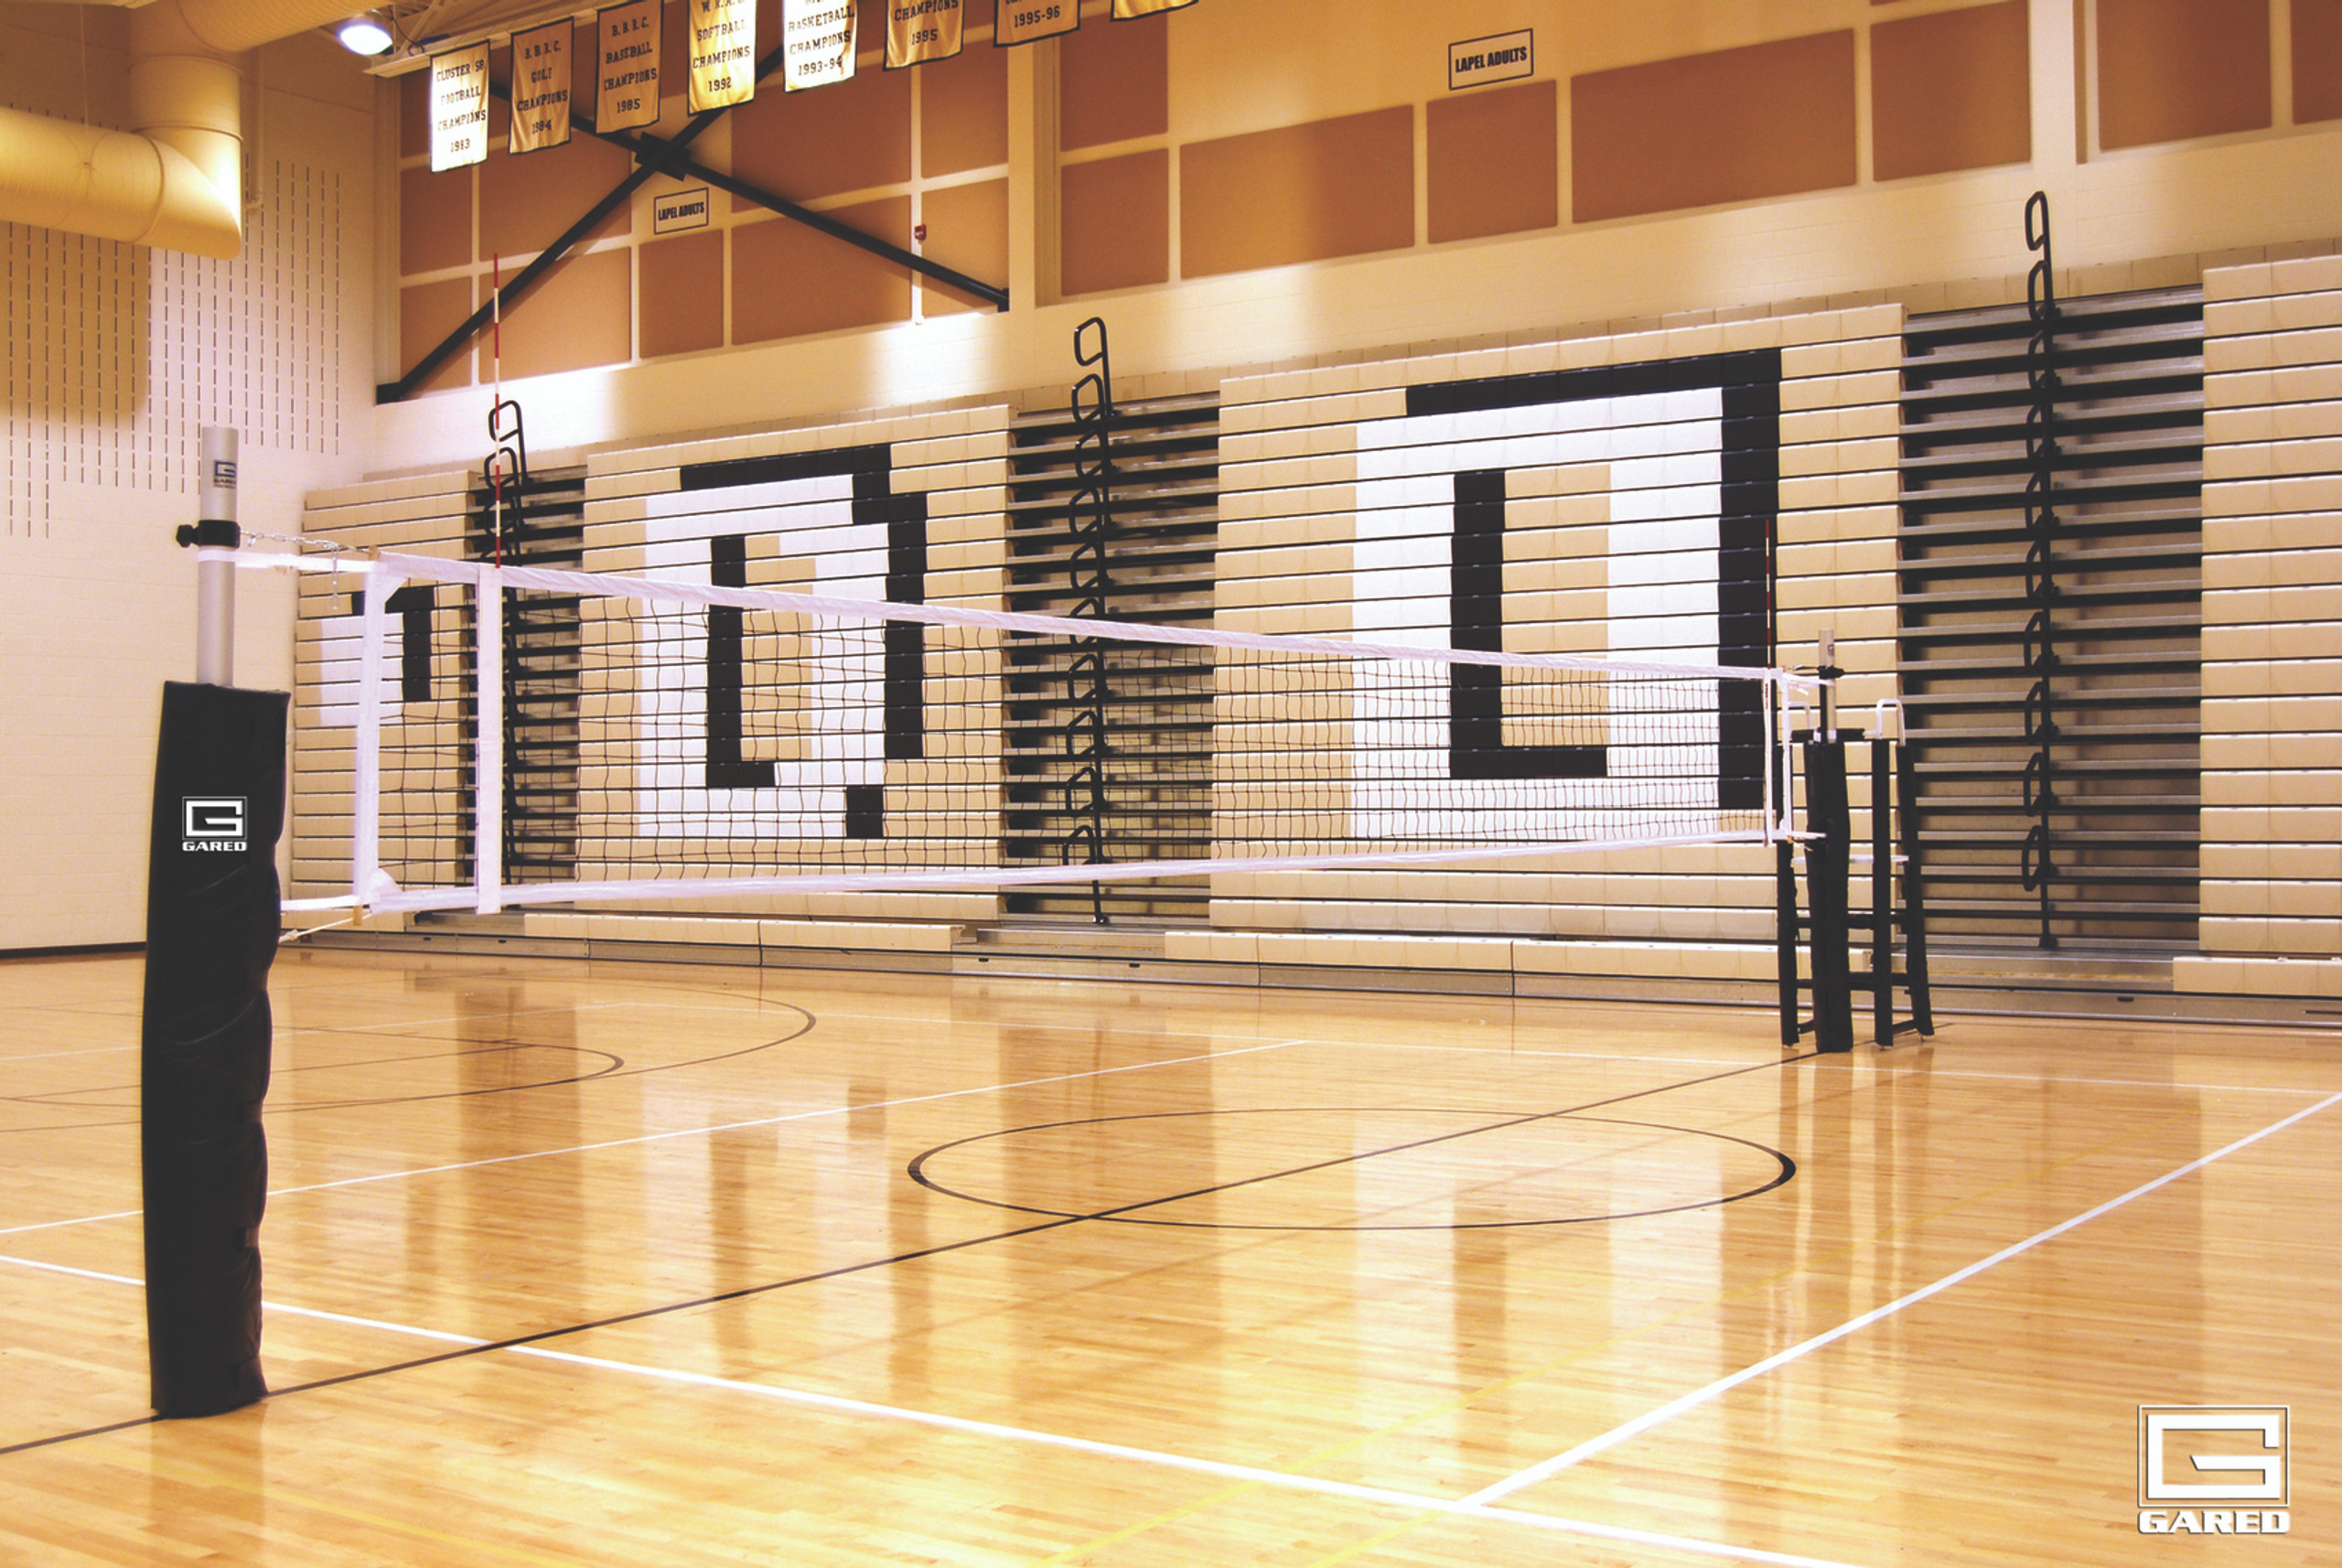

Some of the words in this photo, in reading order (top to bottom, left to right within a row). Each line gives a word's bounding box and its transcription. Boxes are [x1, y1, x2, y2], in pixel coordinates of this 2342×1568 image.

[788, 5, 854, 32] BASKETBALL
[895, 0, 959, 21] CHAMPIONS
[1015, 5, 1060, 28] 1995-96
[697, 19, 746, 42] SOFTBALL
[912, 28, 938, 46] 1995
[606, 41, 652, 64] BASEBALL
[790, 29, 851, 55] CHAMPIONS
[693, 46, 750, 69] CHAMPIONS
[798, 55, 843, 76] 1993-94
[1456, 54, 1486, 73] LAPEL
[1487, 46, 1527, 67] ADULTS
[436, 63, 470, 81] CLUSTER
[604, 68, 657, 91] CHAMPIONS
[708, 76, 731, 92] 1992
[440, 86, 481, 105] FOOTBALL
[517, 90, 568, 111] CHAMPIONS
[617, 98, 640, 113] 1985
[437, 109, 486, 131] CHAMPIONS
[658, 207, 678, 221] LAPEL
[678, 201, 704, 217] ADULTS
[182, 841, 247, 852] GARED
